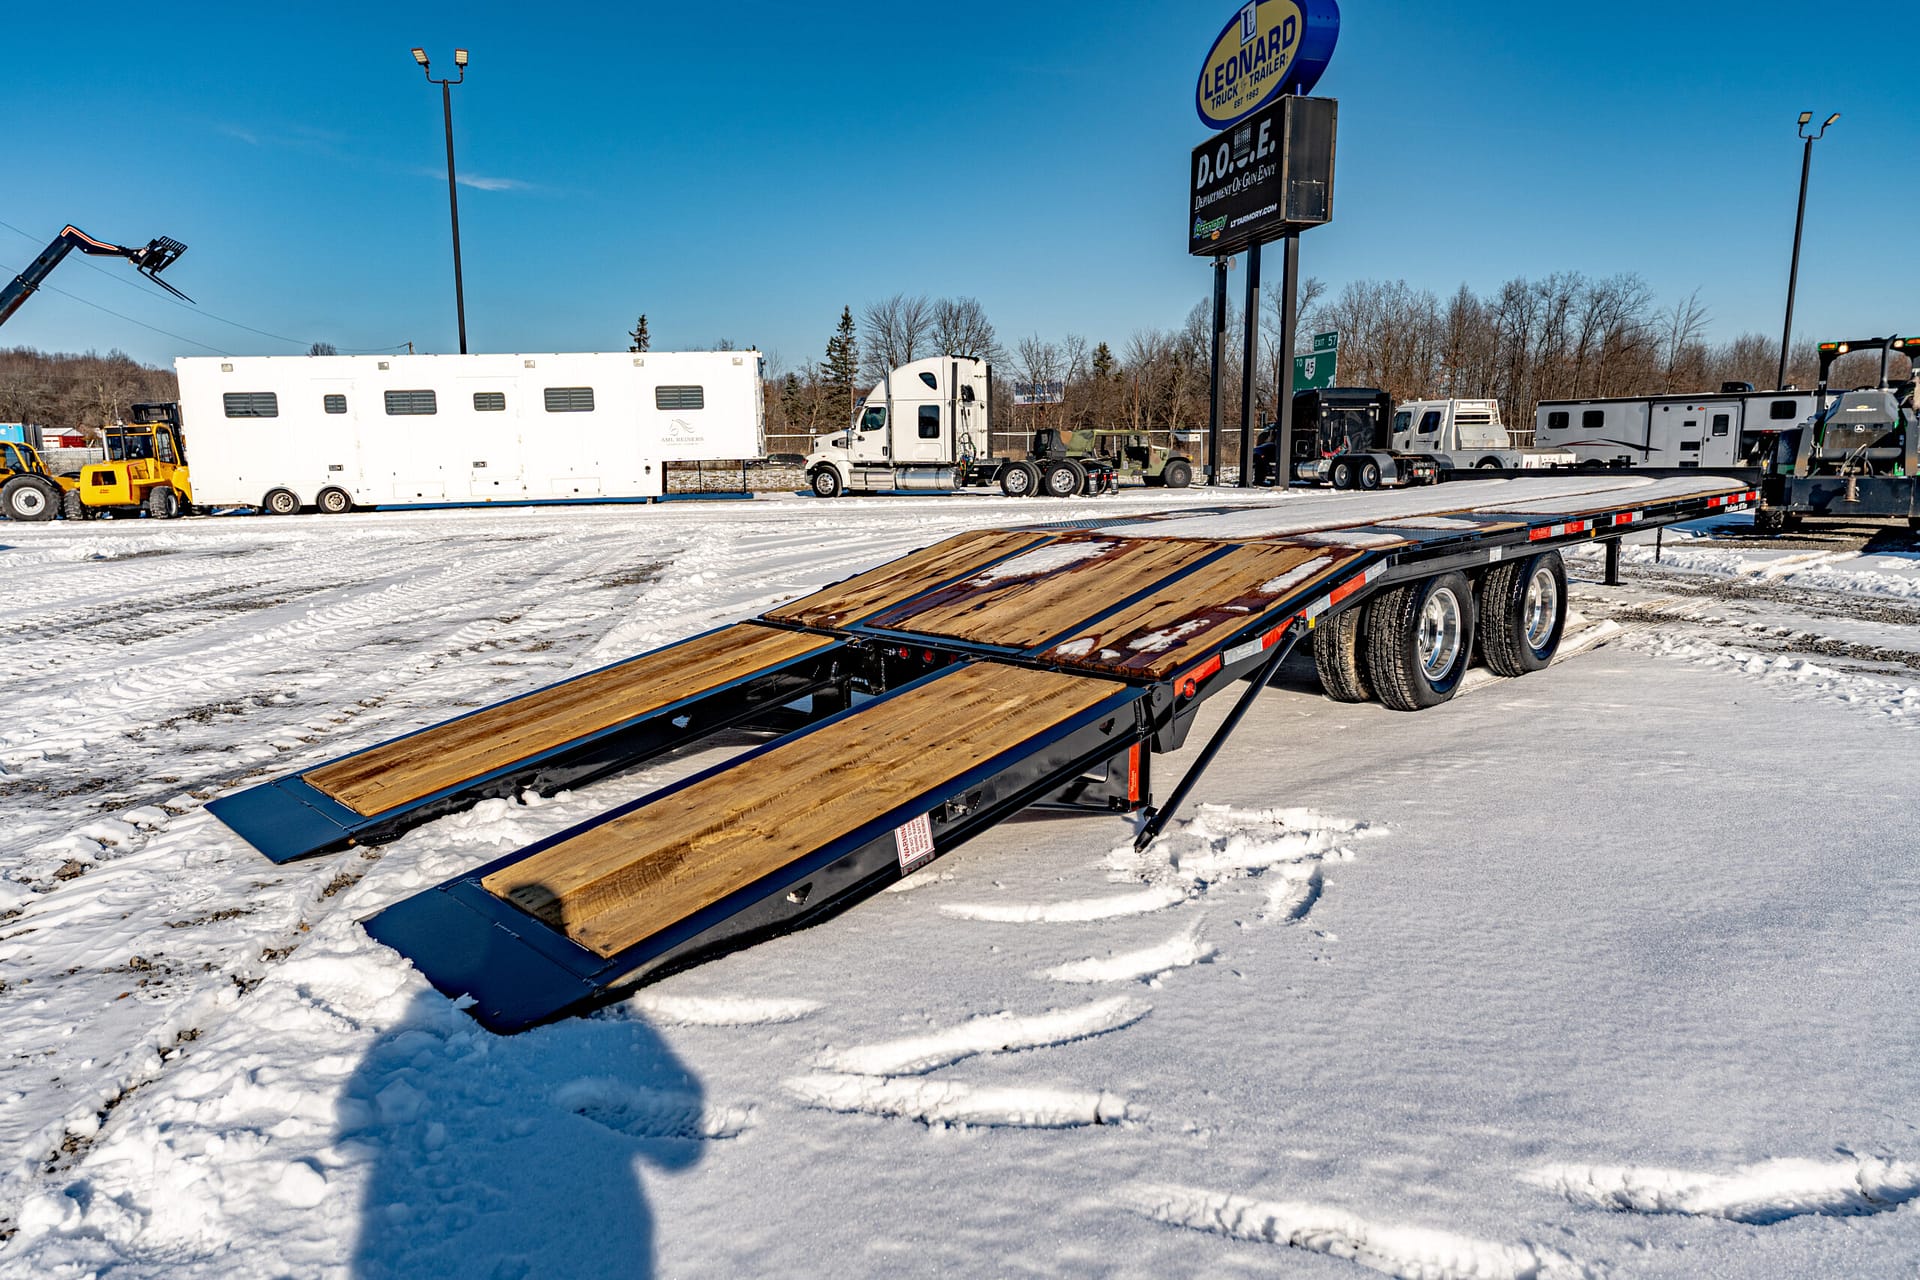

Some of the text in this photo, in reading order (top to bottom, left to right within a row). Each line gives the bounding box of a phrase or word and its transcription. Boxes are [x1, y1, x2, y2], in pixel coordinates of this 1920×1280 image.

[1204, 14, 1295, 100] LEONARD
[1211, 83, 1239, 111] TRUCK
[1249, 53, 1286, 87] TRAILER
[1328, 334, 1337, 346] 57
[1296, 358, 1303, 367] TO
[1306, 361, 1314, 374] 45
